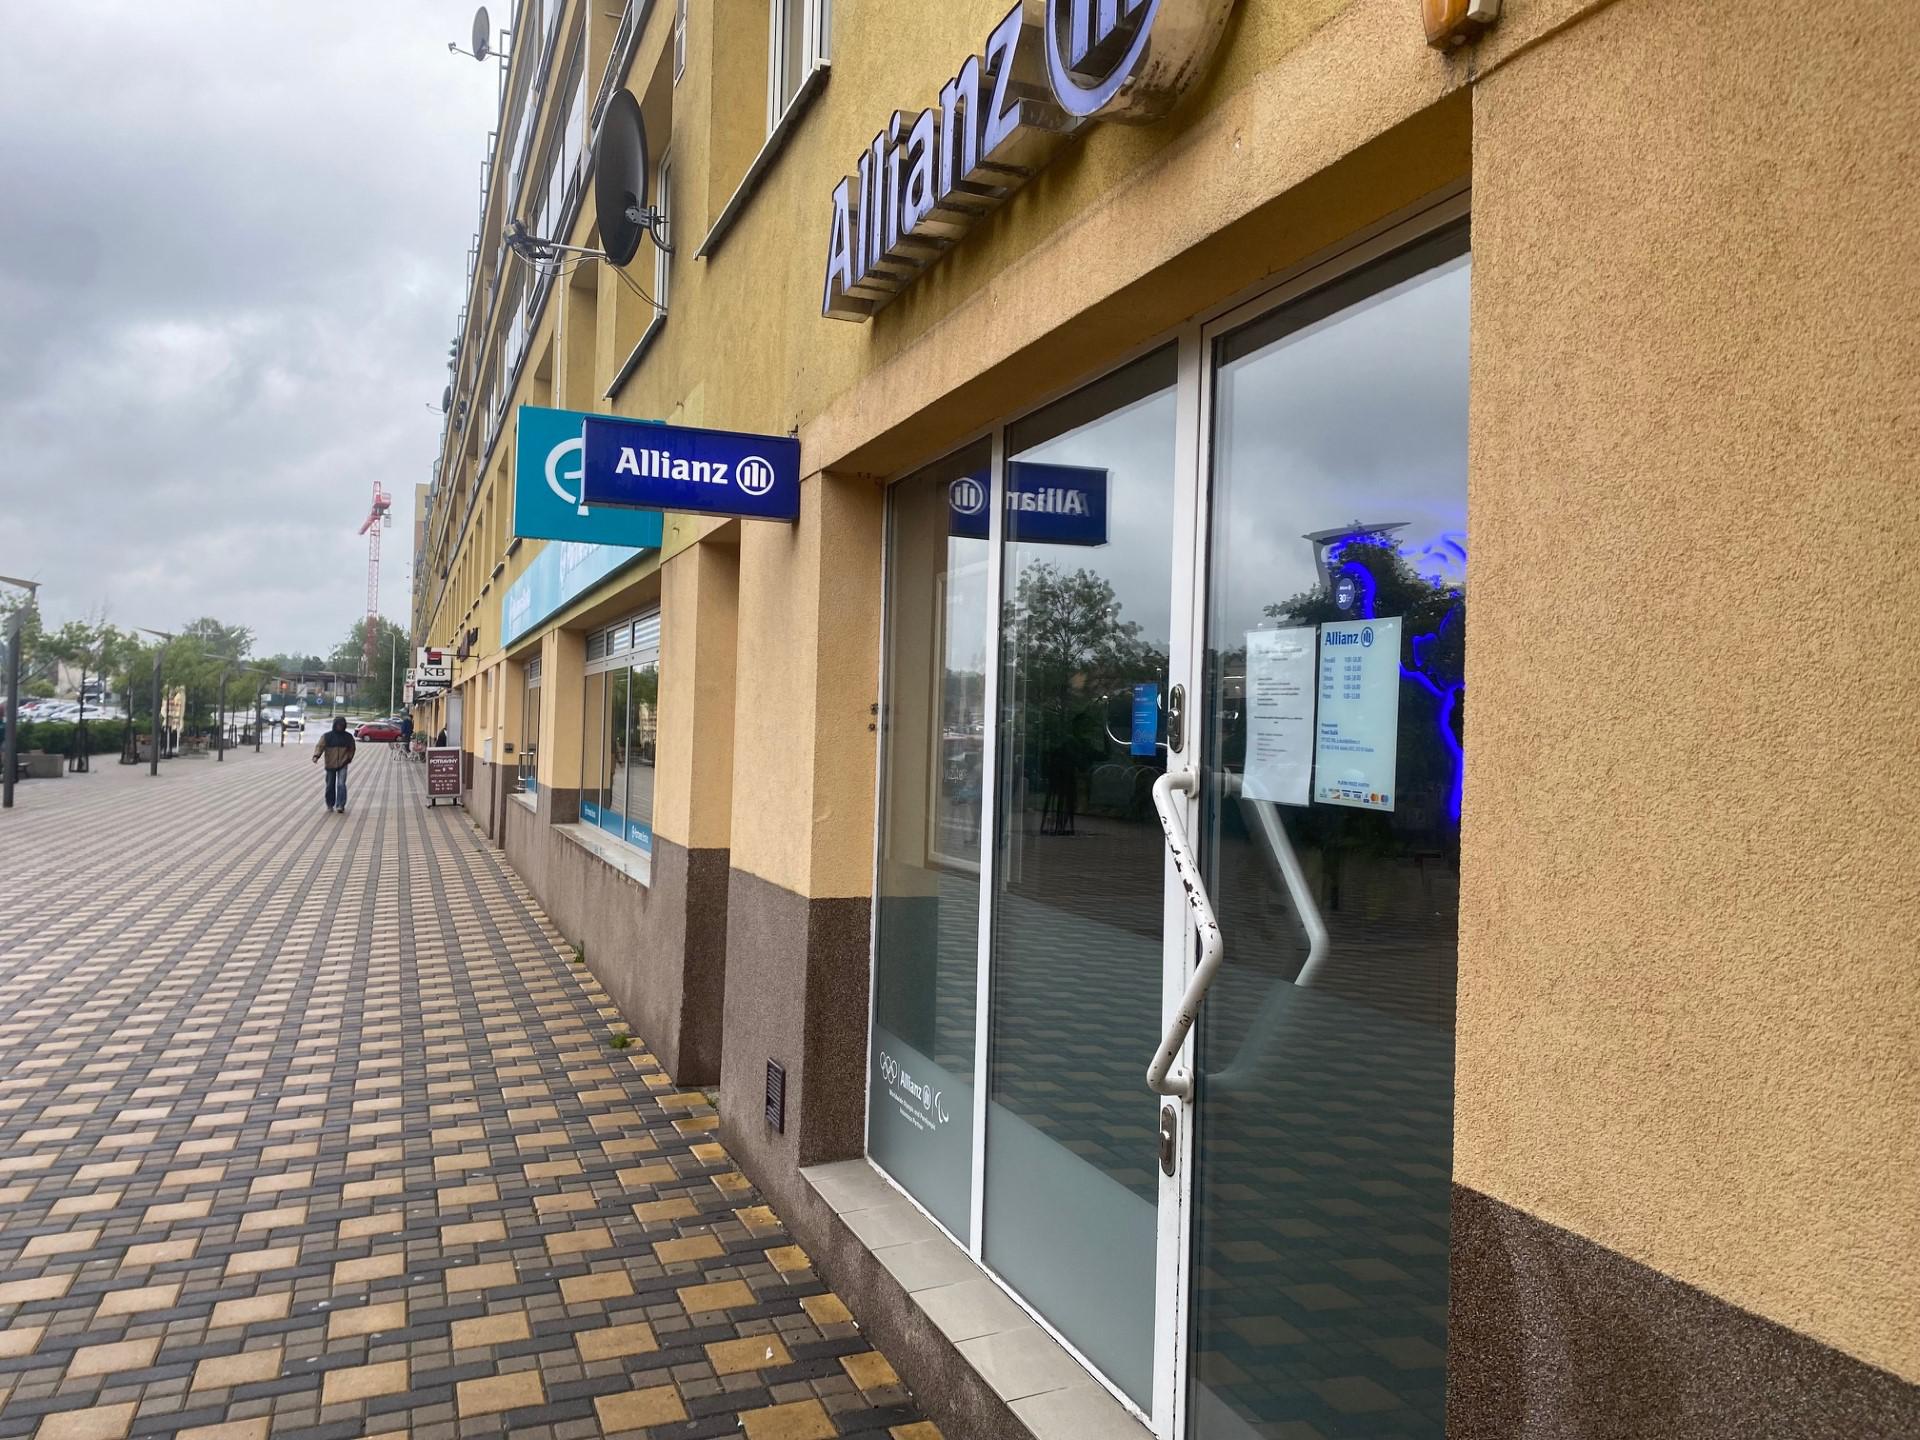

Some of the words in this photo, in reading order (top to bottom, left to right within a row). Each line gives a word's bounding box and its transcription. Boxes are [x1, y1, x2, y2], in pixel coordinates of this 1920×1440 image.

[822, 0, 1023, 318] Allianz
[615, 446, 729, 485] Allianz
[1324, 631, 1359, 646] Allianz
[424, 667, 446, 677] KB
[900, 1069, 922, 1101] Allianz
